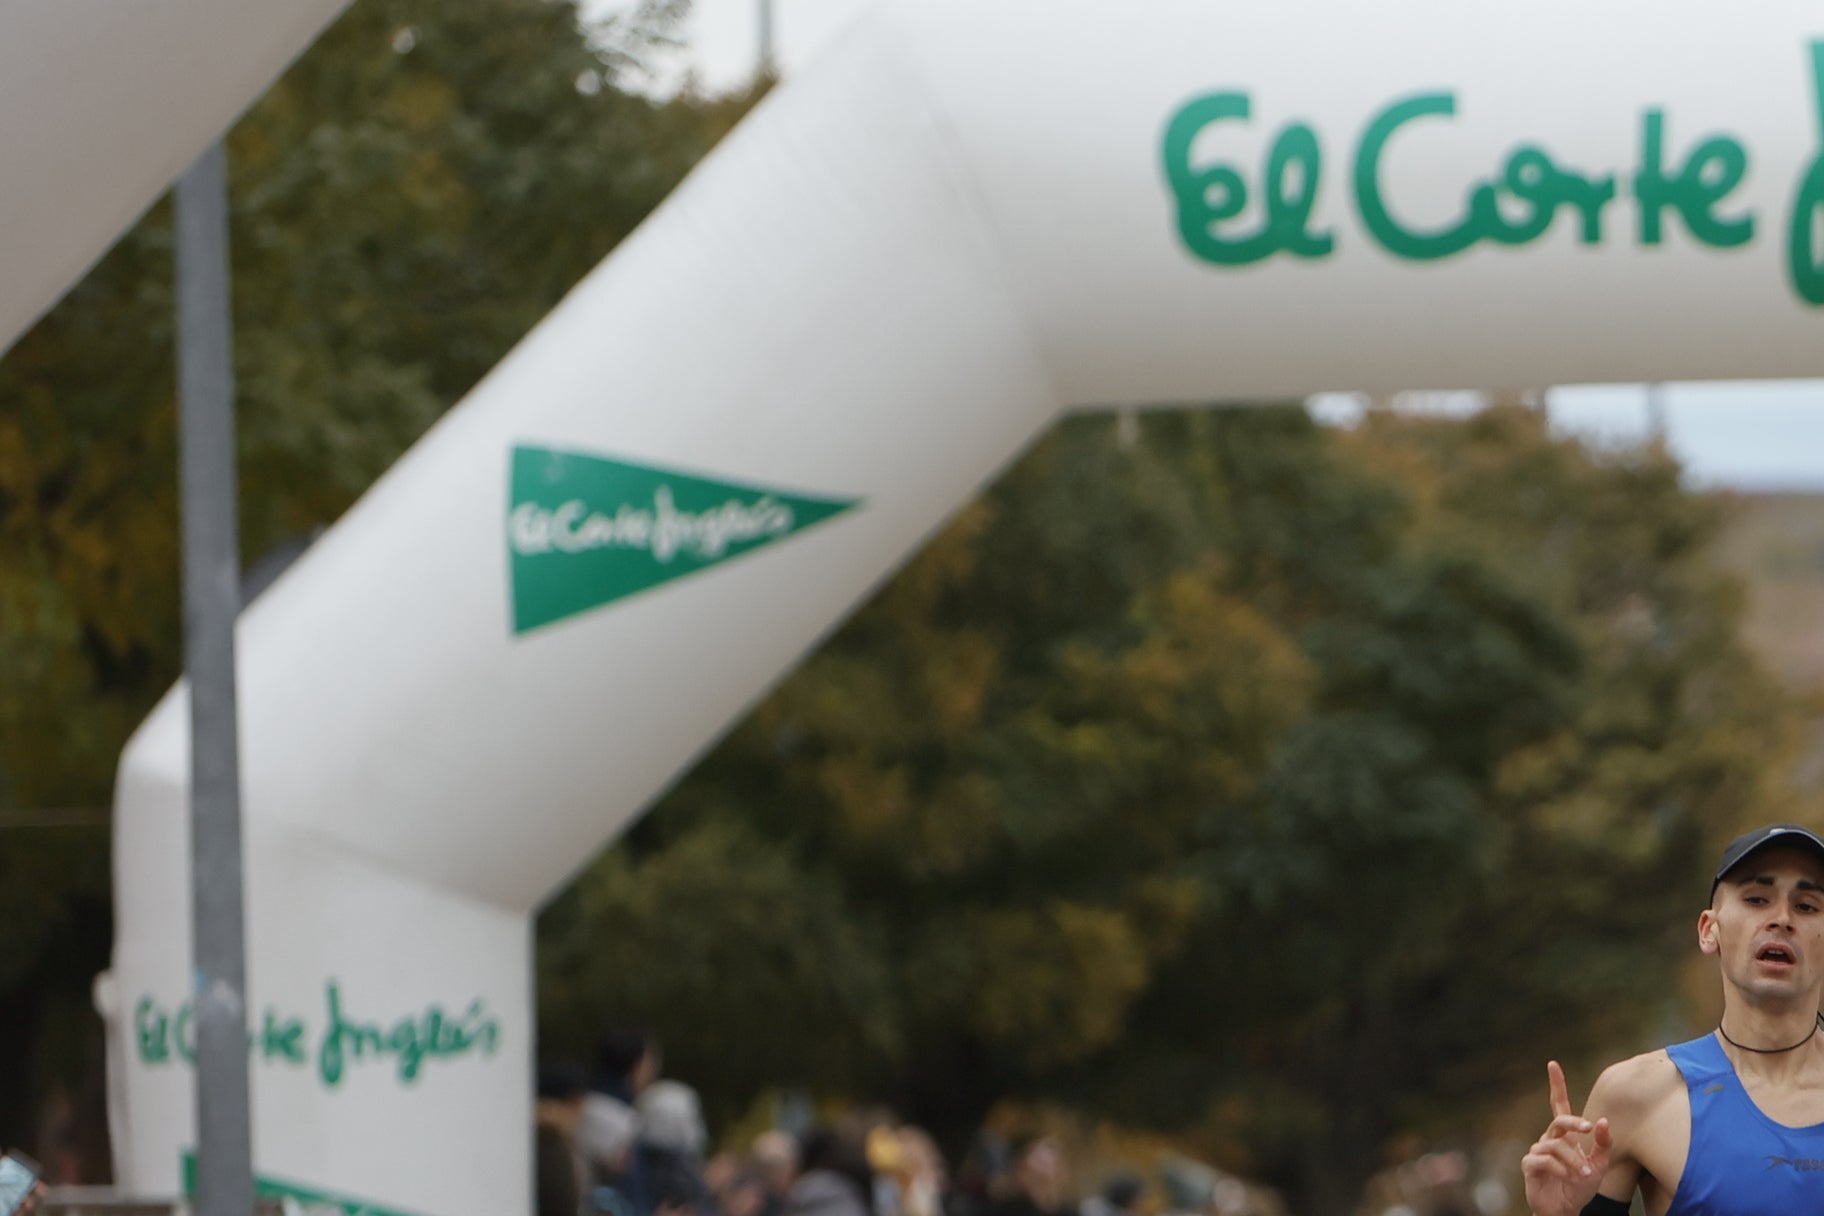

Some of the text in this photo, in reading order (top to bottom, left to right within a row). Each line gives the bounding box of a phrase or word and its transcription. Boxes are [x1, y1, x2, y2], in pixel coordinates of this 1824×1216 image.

[1158, 87, 1336, 268] El
[1350, 88, 1758, 262] Corte
[319, 978, 502, 1088] Inglés
